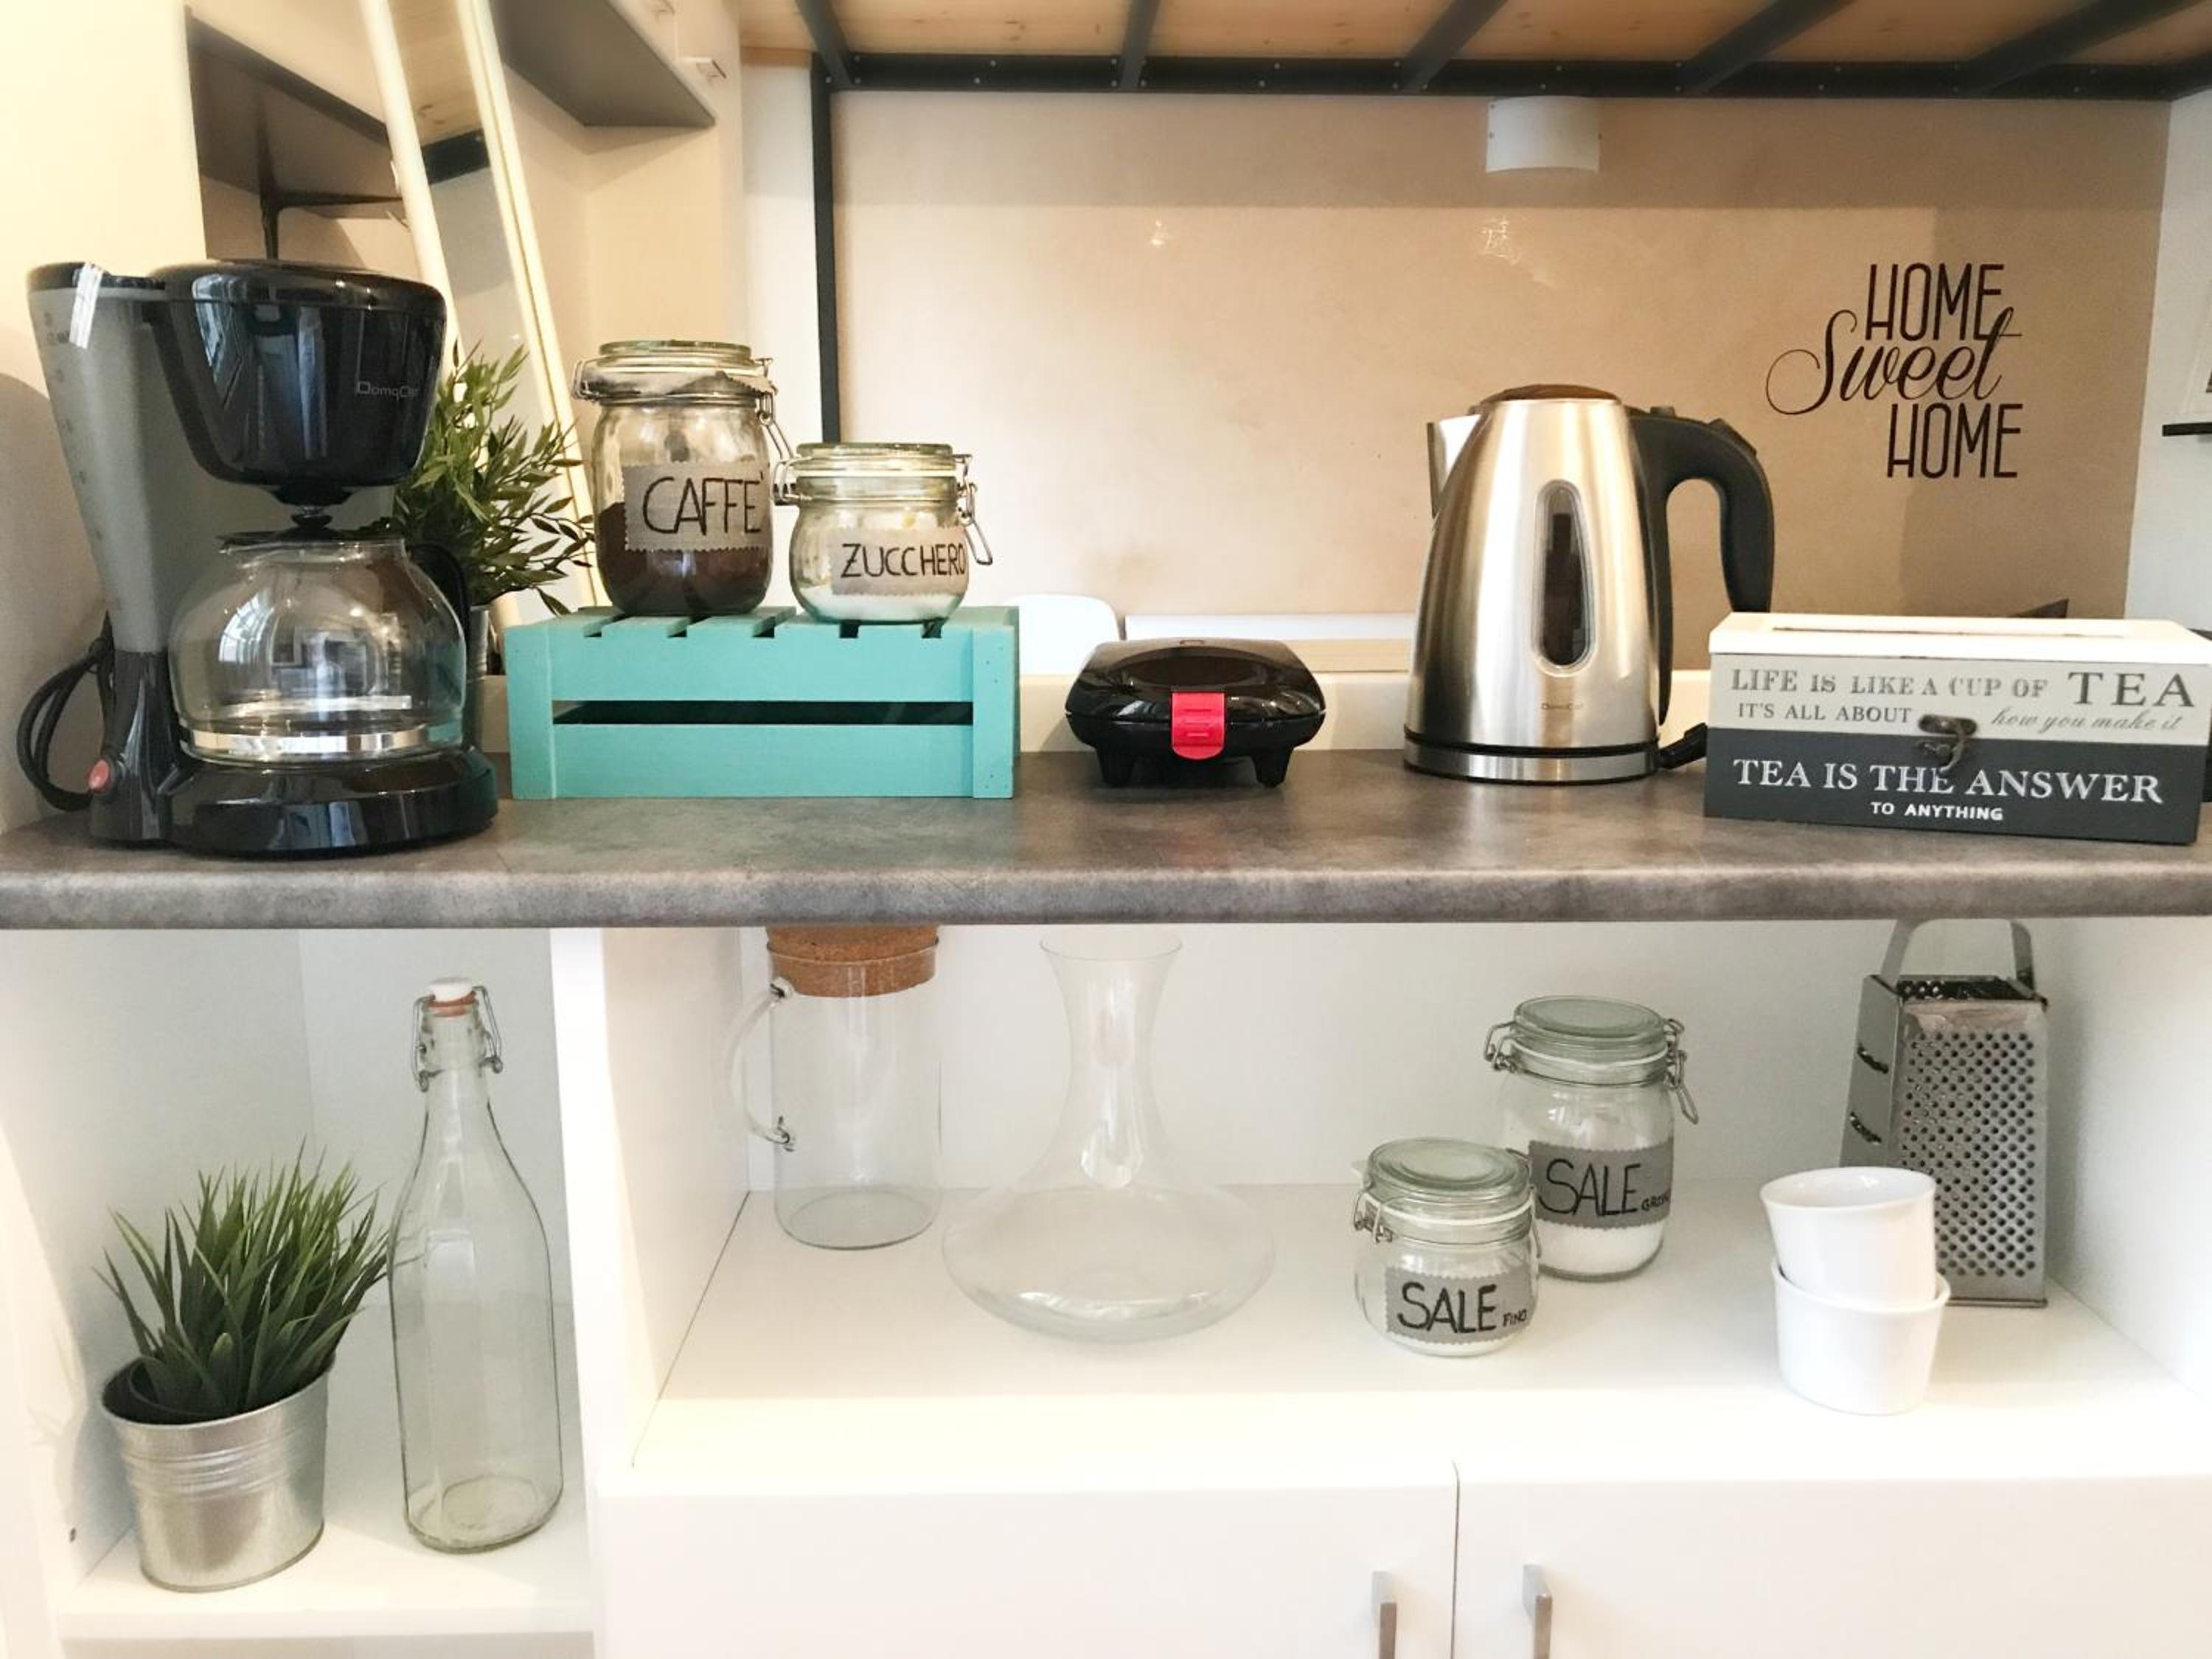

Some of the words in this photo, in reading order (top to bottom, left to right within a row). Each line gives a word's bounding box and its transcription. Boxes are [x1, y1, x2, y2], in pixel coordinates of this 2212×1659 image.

[1865, 262, 2005, 341] HOME
[1766, 306, 2023, 415] Sweet
[1887, 403, 2023, 479] HOME
[840, 542, 967, 578] ZUCCHERO
[1732, 668, 1798, 692] LIFE
[1810, 673, 1837, 694] IS
[1850, 675, 1915, 696] LIKE
[1921, 678, 1938, 697] A
[1947, 675, 2003, 698] CUP
[2011, 677, 2048, 699] OF
[2067, 671, 2195, 708] TEA
[1738, 702, 1775, 720] IT'S
[1784, 704, 1826, 722] ALL
[1834, 705, 1913, 724] ABOUT
[1990, 706, 2038, 726] how
[2038, 714, 2086, 734] you
[2090, 709, 2157, 731] make
[2160, 714, 2183, 732] it
[1733, 758, 1812, 789] TEA
[1823, 762, 1859, 791] IS
[1868, 764, 1955, 795] THE
[1964, 768, 2164, 805] ANSWER
[1869, 801, 1896, 816] TO
[1903, 802, 2004, 821] ANYTHING
[1537, 1158, 1642, 1217] SALE
[1397, 1281, 1498, 1334] SALE
[1502, 1308, 1528, 1328] FINO
